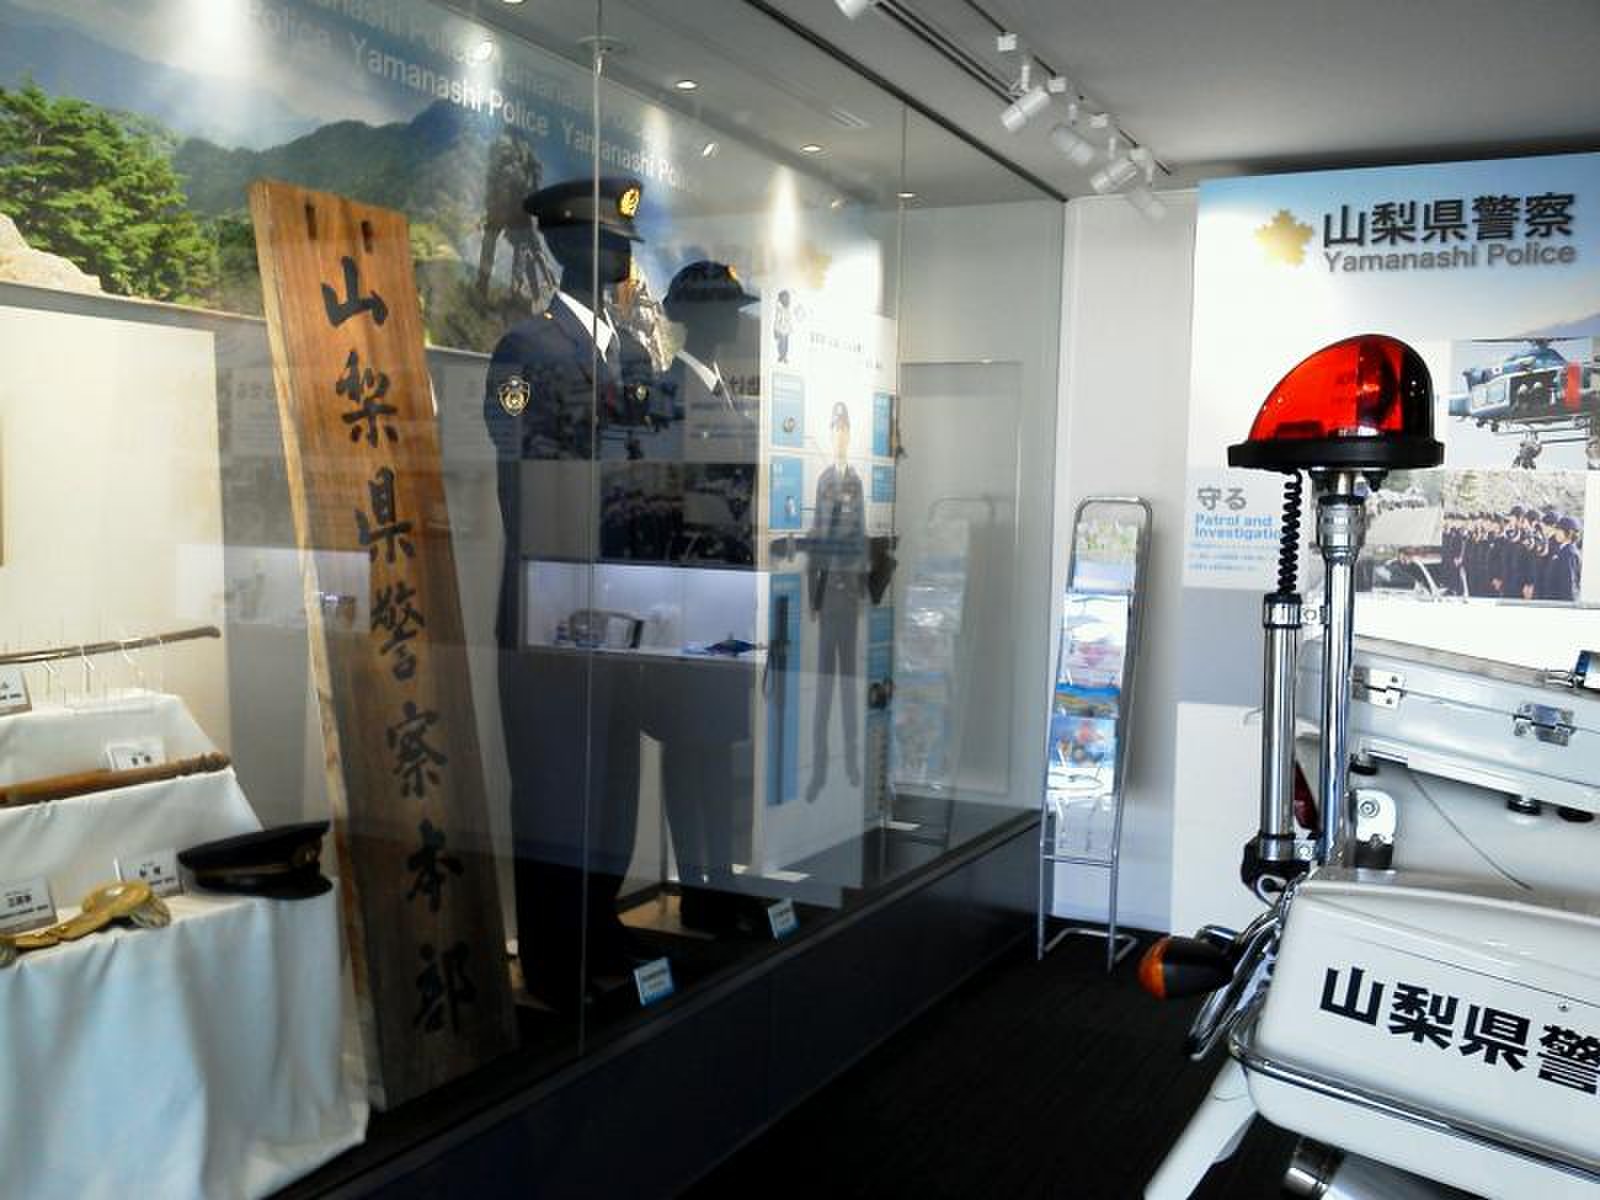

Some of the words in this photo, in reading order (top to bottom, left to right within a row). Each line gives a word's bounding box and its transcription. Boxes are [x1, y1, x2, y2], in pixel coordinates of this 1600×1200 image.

[350, 33, 483, 114] Yamanashi
[488, 88, 550, 136] Police
[1323, 191, 1575, 248] 山梨県警察
[1323, 243, 1477, 272] Yamanashi
[1487, 241, 1577, 267] Police
[1195, 512, 1239, 526] Patrol
[1244, 514, 1273, 527] and
[1197, 486, 1247, 511] 守る
[1195, 527, 1281, 540] Investigatio
[320, 254, 477, 1035] 山梨県警察本部
[1319, 966, 1600, 1095] 山梨県警
